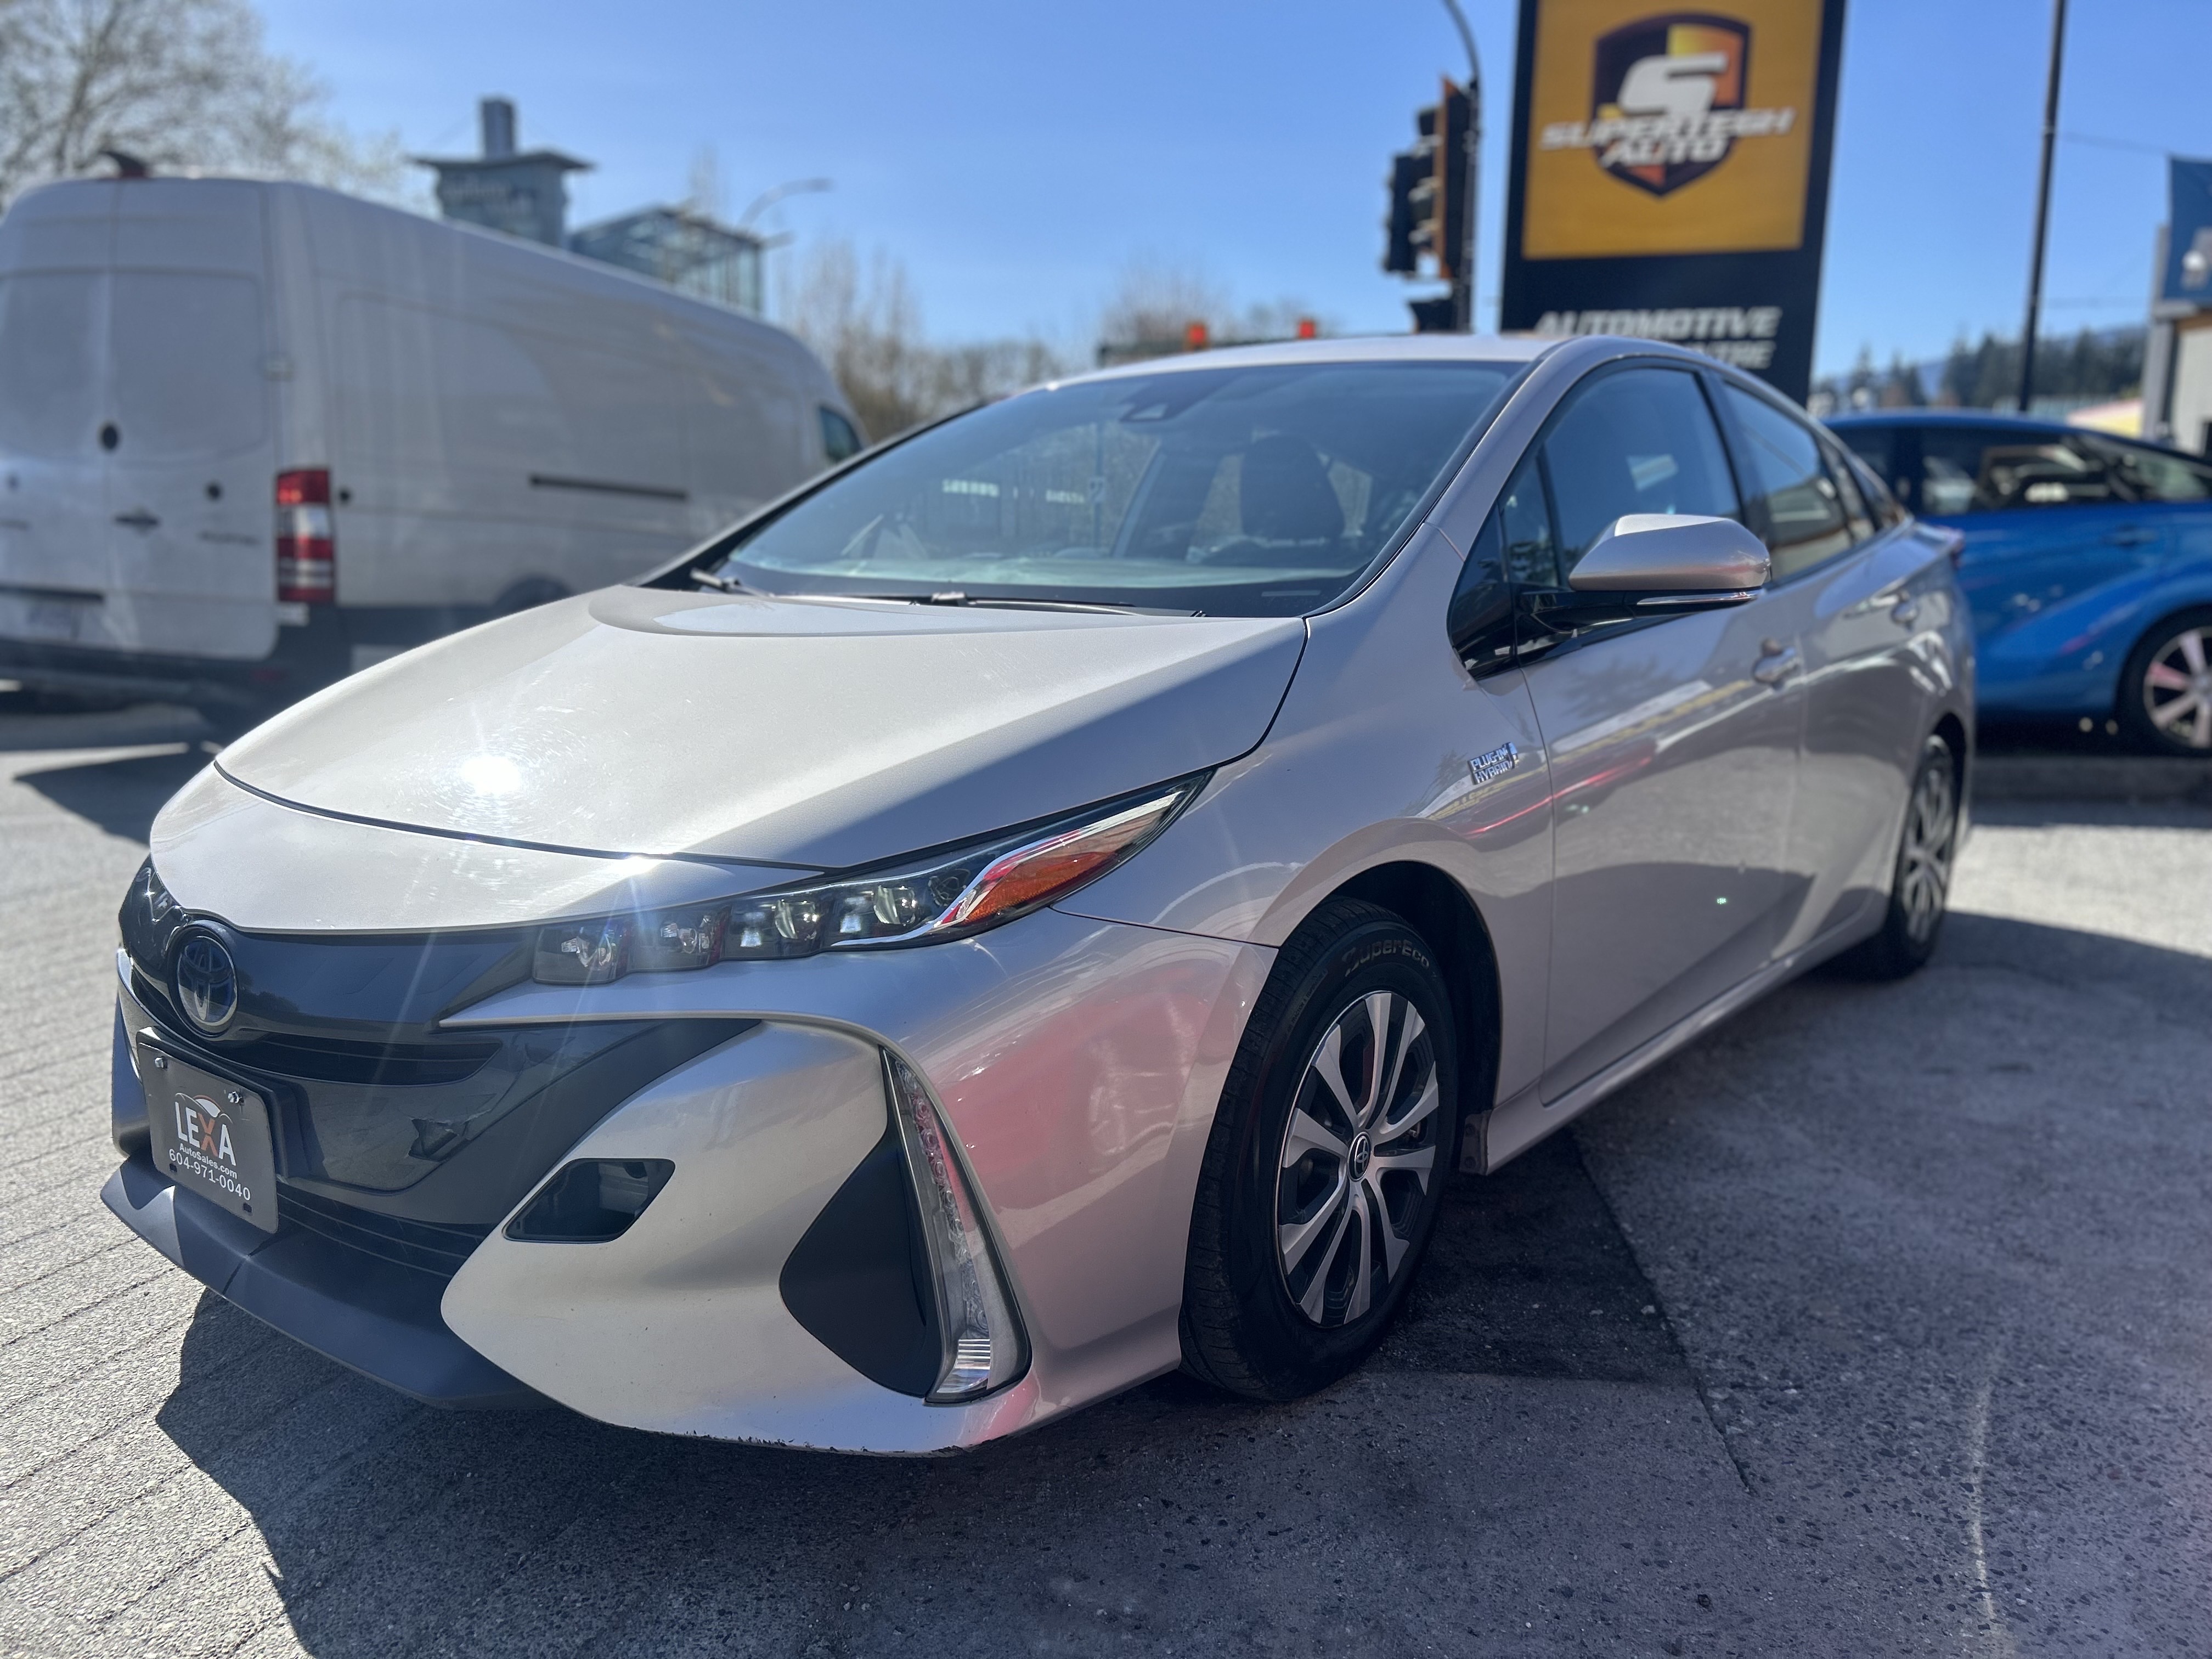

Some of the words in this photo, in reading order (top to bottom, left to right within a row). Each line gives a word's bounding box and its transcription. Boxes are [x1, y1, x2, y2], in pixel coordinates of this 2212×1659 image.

[1600, 137, 1729, 168] AUTO
[1534, 306, 1781, 336] AUTOMOTIVE
[1474, 761, 1513, 783] HYBRID
[175, 1102, 236, 1166] LEXA
[169, 1148, 251, 1201] 604-971-0040
[179, 1144, 238, 1180] AutoSales.com
